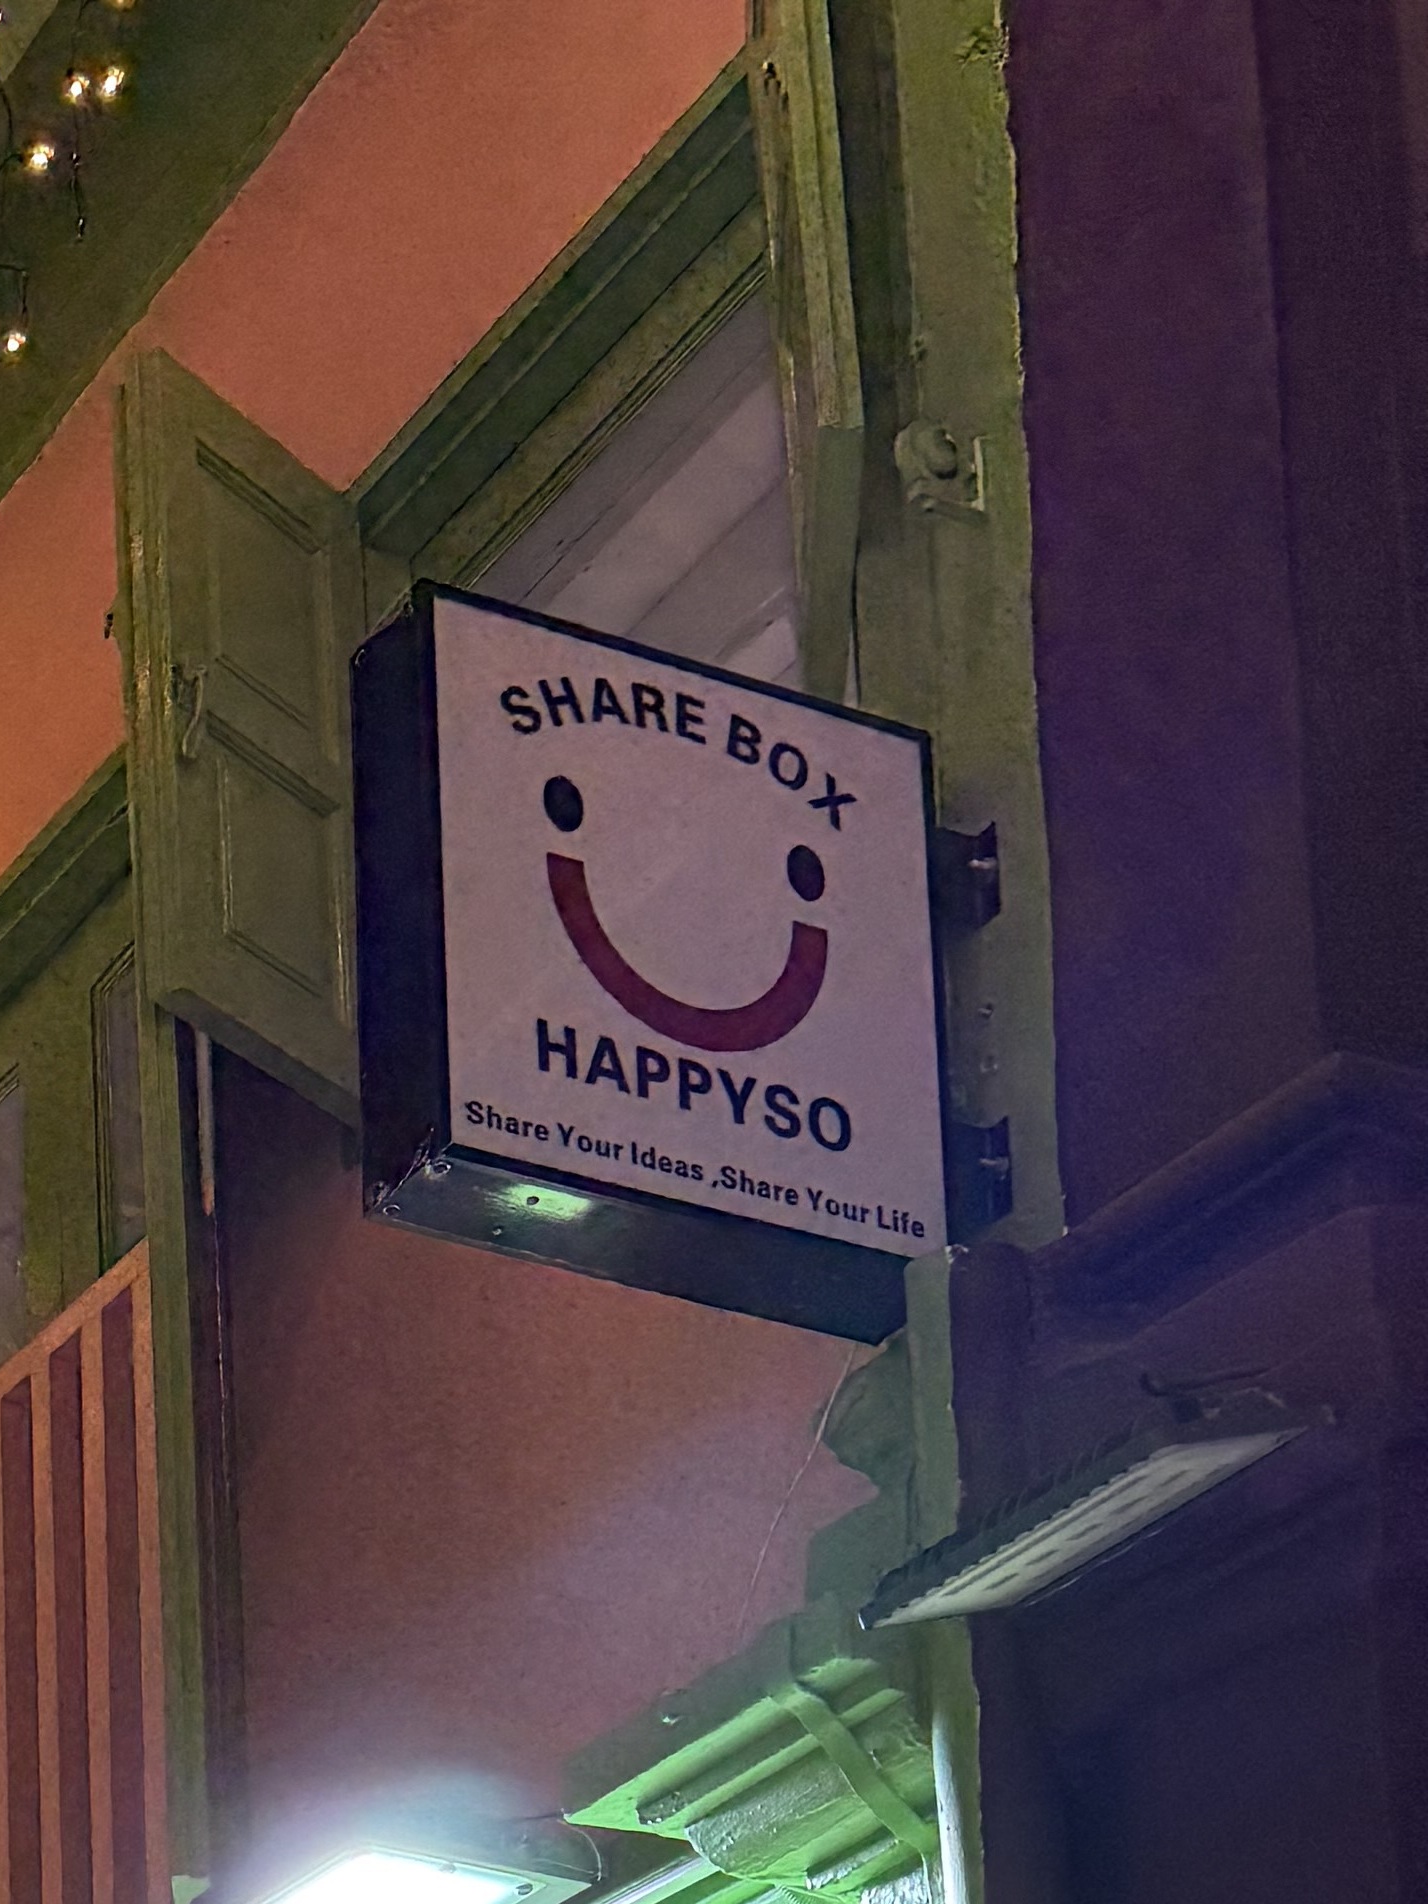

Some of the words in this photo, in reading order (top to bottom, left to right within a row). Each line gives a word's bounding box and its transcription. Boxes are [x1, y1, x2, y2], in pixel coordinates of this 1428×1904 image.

[501, 676, 706, 745] SHARE
[726, 713, 857, 831] BOX
[536, 1017, 852, 1152] HAPPYSO
[465, 1100, 549, 1142] Share
[557, 1122, 624, 1162] Your
[632, 1141, 704, 1182] Ideas
[806, 1186, 870, 1224] Your
[877, 1204, 925, 1238] Life
